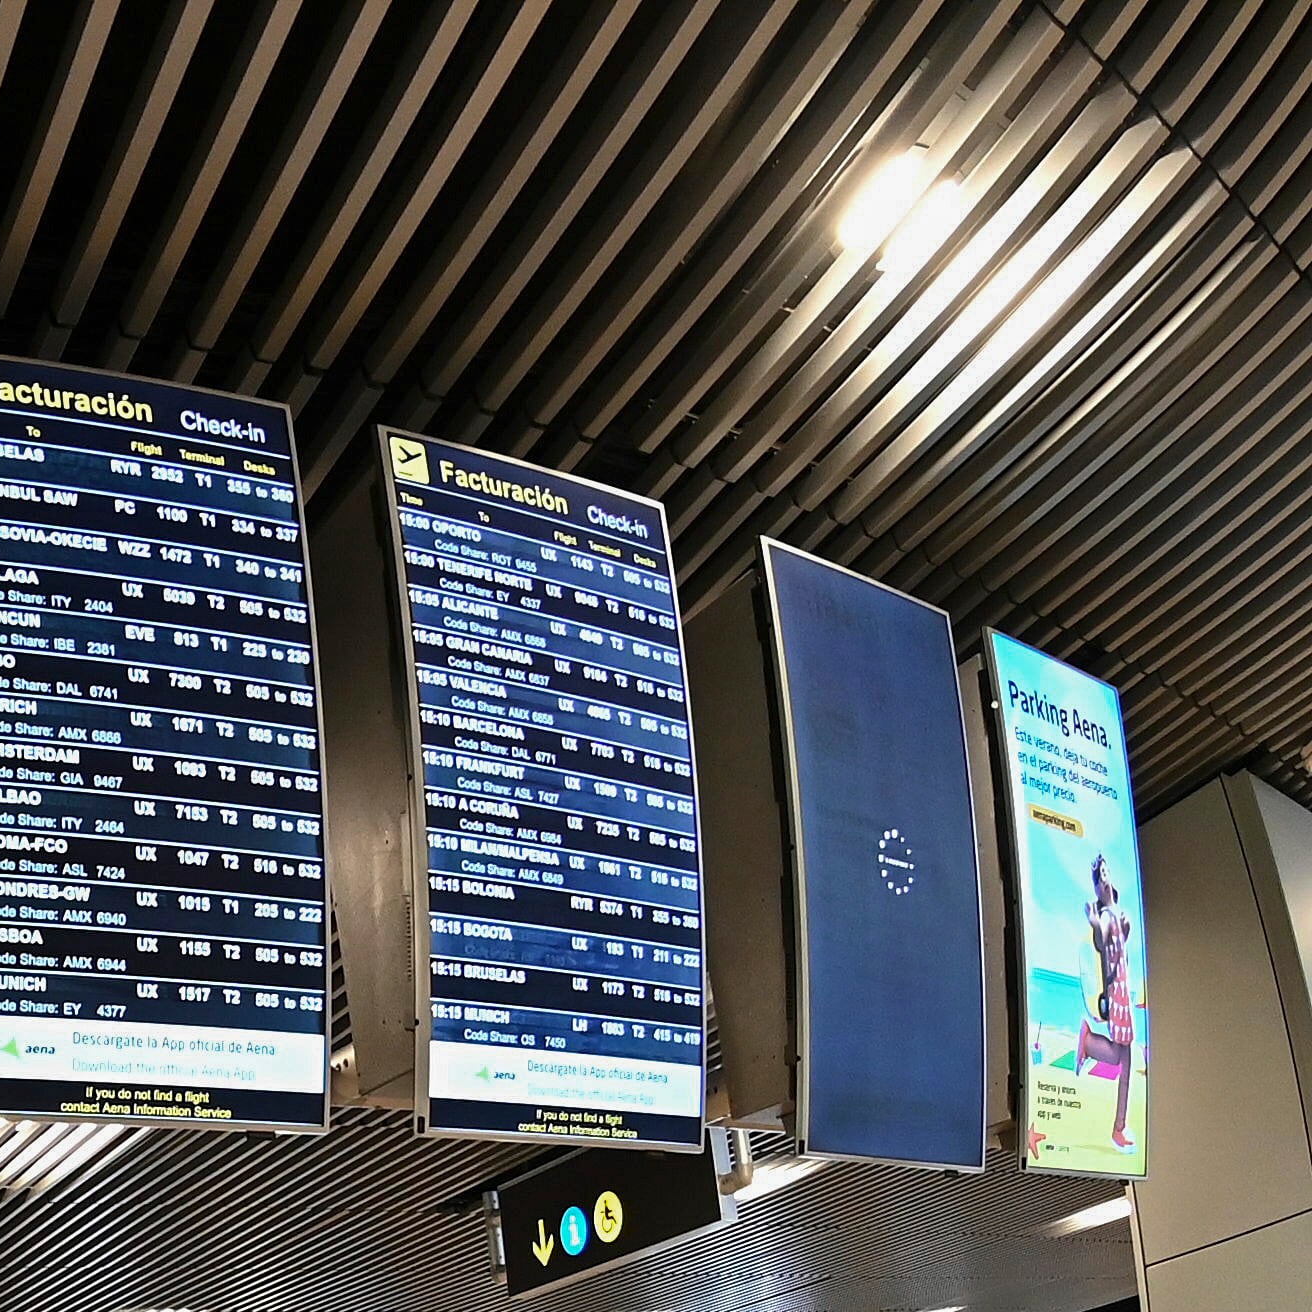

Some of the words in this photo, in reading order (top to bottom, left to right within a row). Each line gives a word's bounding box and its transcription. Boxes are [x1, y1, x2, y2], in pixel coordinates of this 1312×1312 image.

[26, 426, 40, 437] To
[180, 410, 266, 444] Check-in
[439, 459, 569, 515] Facturación
[587, 505, 648, 539] Check-in
[115, 500, 135, 514] PC
[157, 506, 187, 522] 1100
[199, 513, 215, 527] T1
[232, 519, 255, 534] 334
[260, 526, 272, 537] to
[276, 527, 298, 542] 337
[1008, 680, 1070, 738] Parking
[1073, 709, 1111, 749] Aena.
[1015, 727, 1032, 745] Este
[1080, 755, 1087, 767] tu
[1018, 752, 1028, 764] en
[1029, 753, 1037, 767] el
[1039, 755, 1071, 782] parking
[1068, 765, 1079, 784] del
[1021, 771, 1027, 784] al
[1029, 777, 1050, 795] mejor
[20, 953, 58, 967] Share:
[63, 956, 92, 969] AMX
[97, 958, 126, 971] 6944
